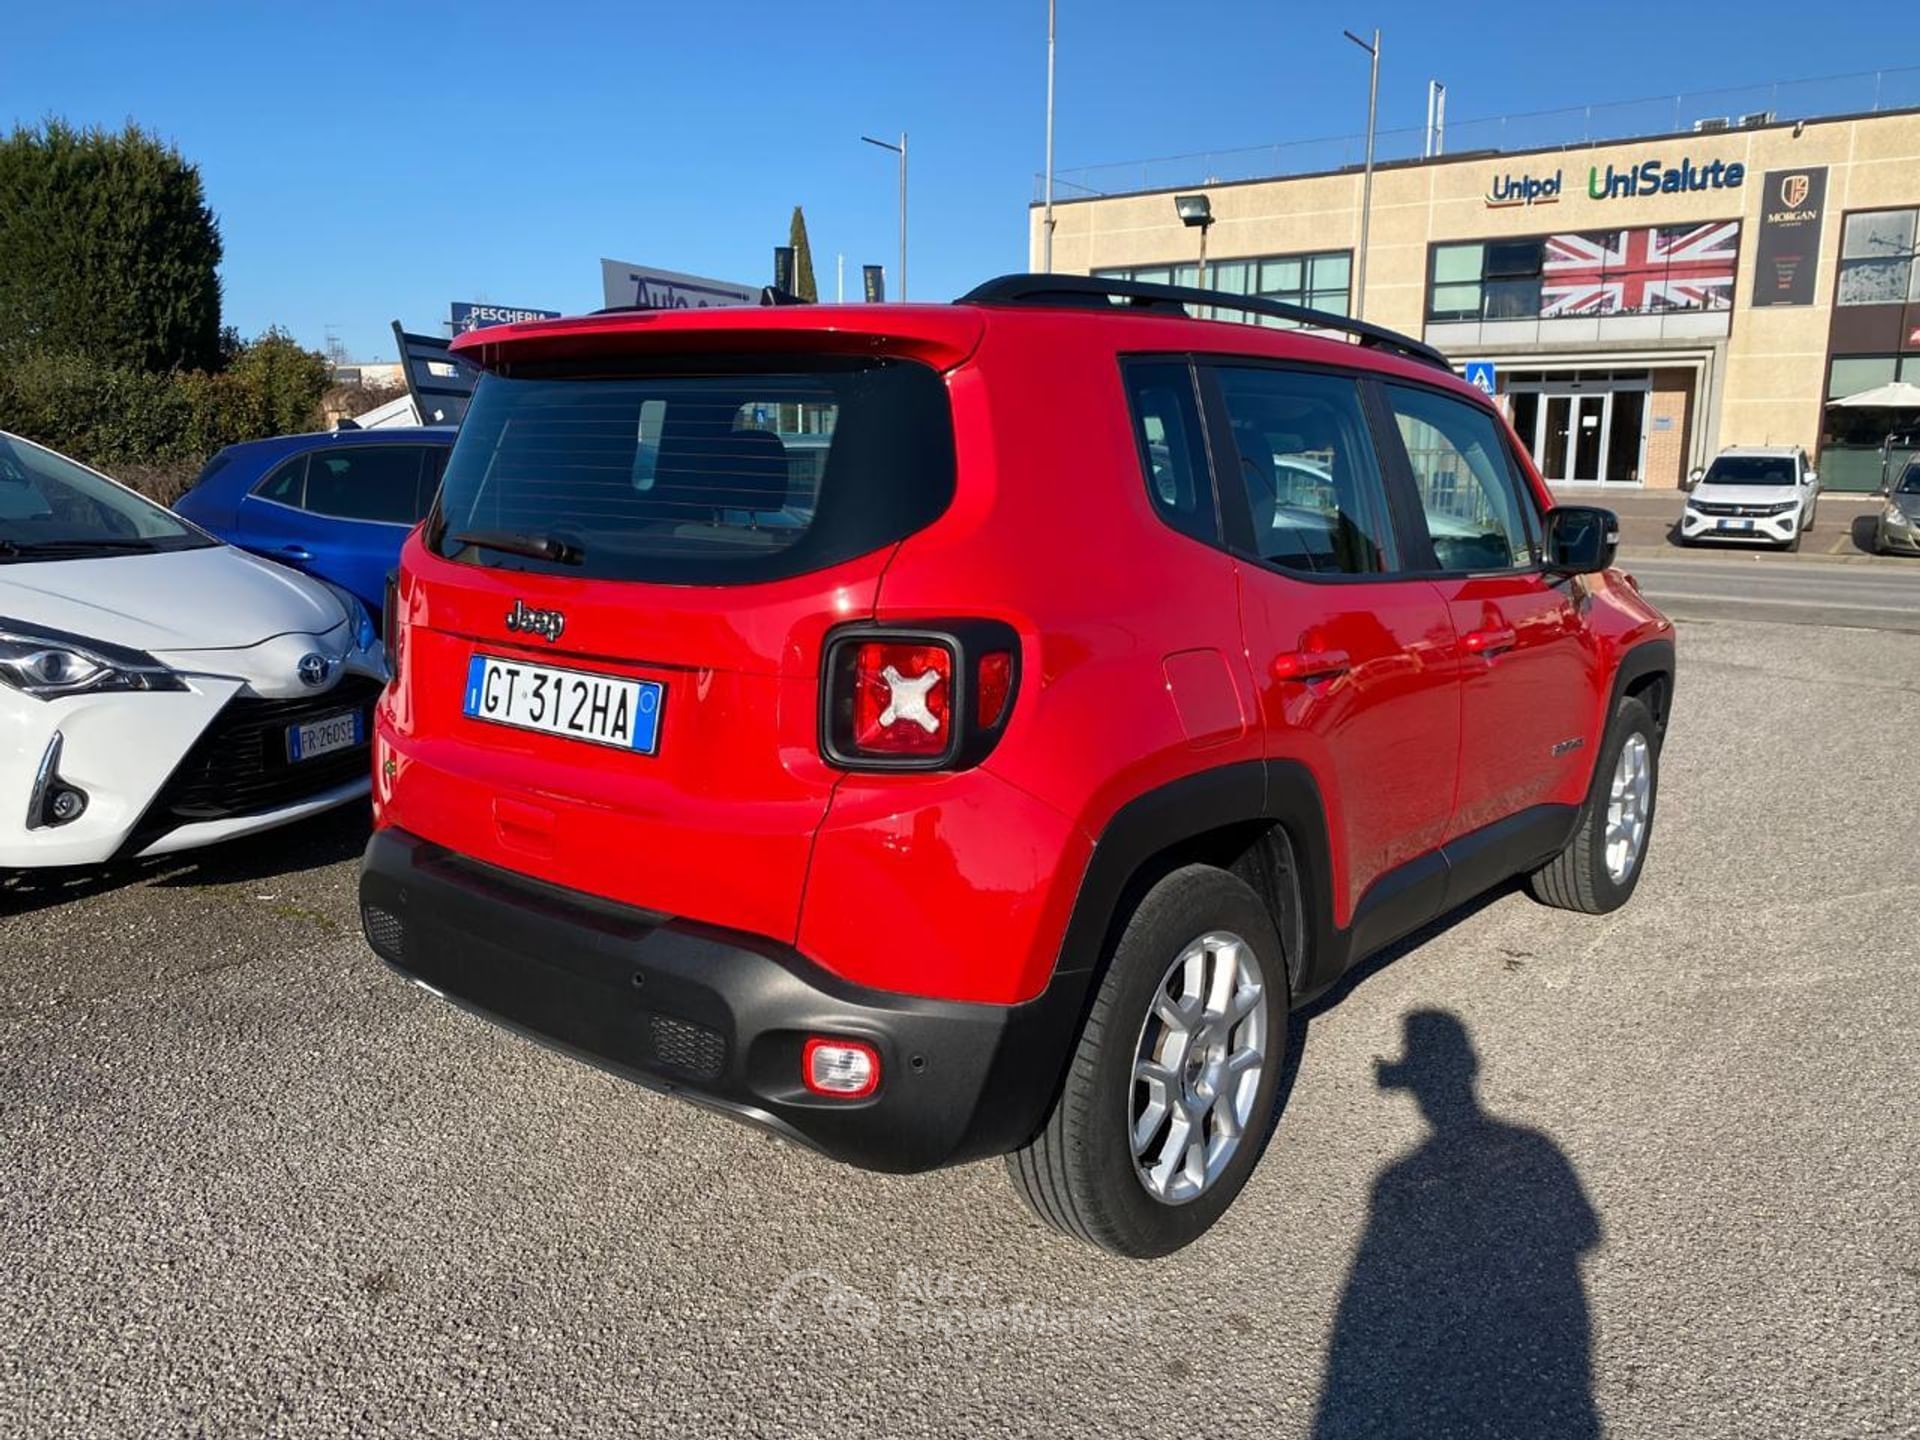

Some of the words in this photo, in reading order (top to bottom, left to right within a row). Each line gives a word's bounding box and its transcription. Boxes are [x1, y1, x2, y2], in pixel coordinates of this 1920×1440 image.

[1493, 169, 1562, 204] Unipol
[1589, 157, 1745, 200] UniSalute
[1768, 210, 1817, 224] MORGAN
[506, 599, 565, 643] Jeep
